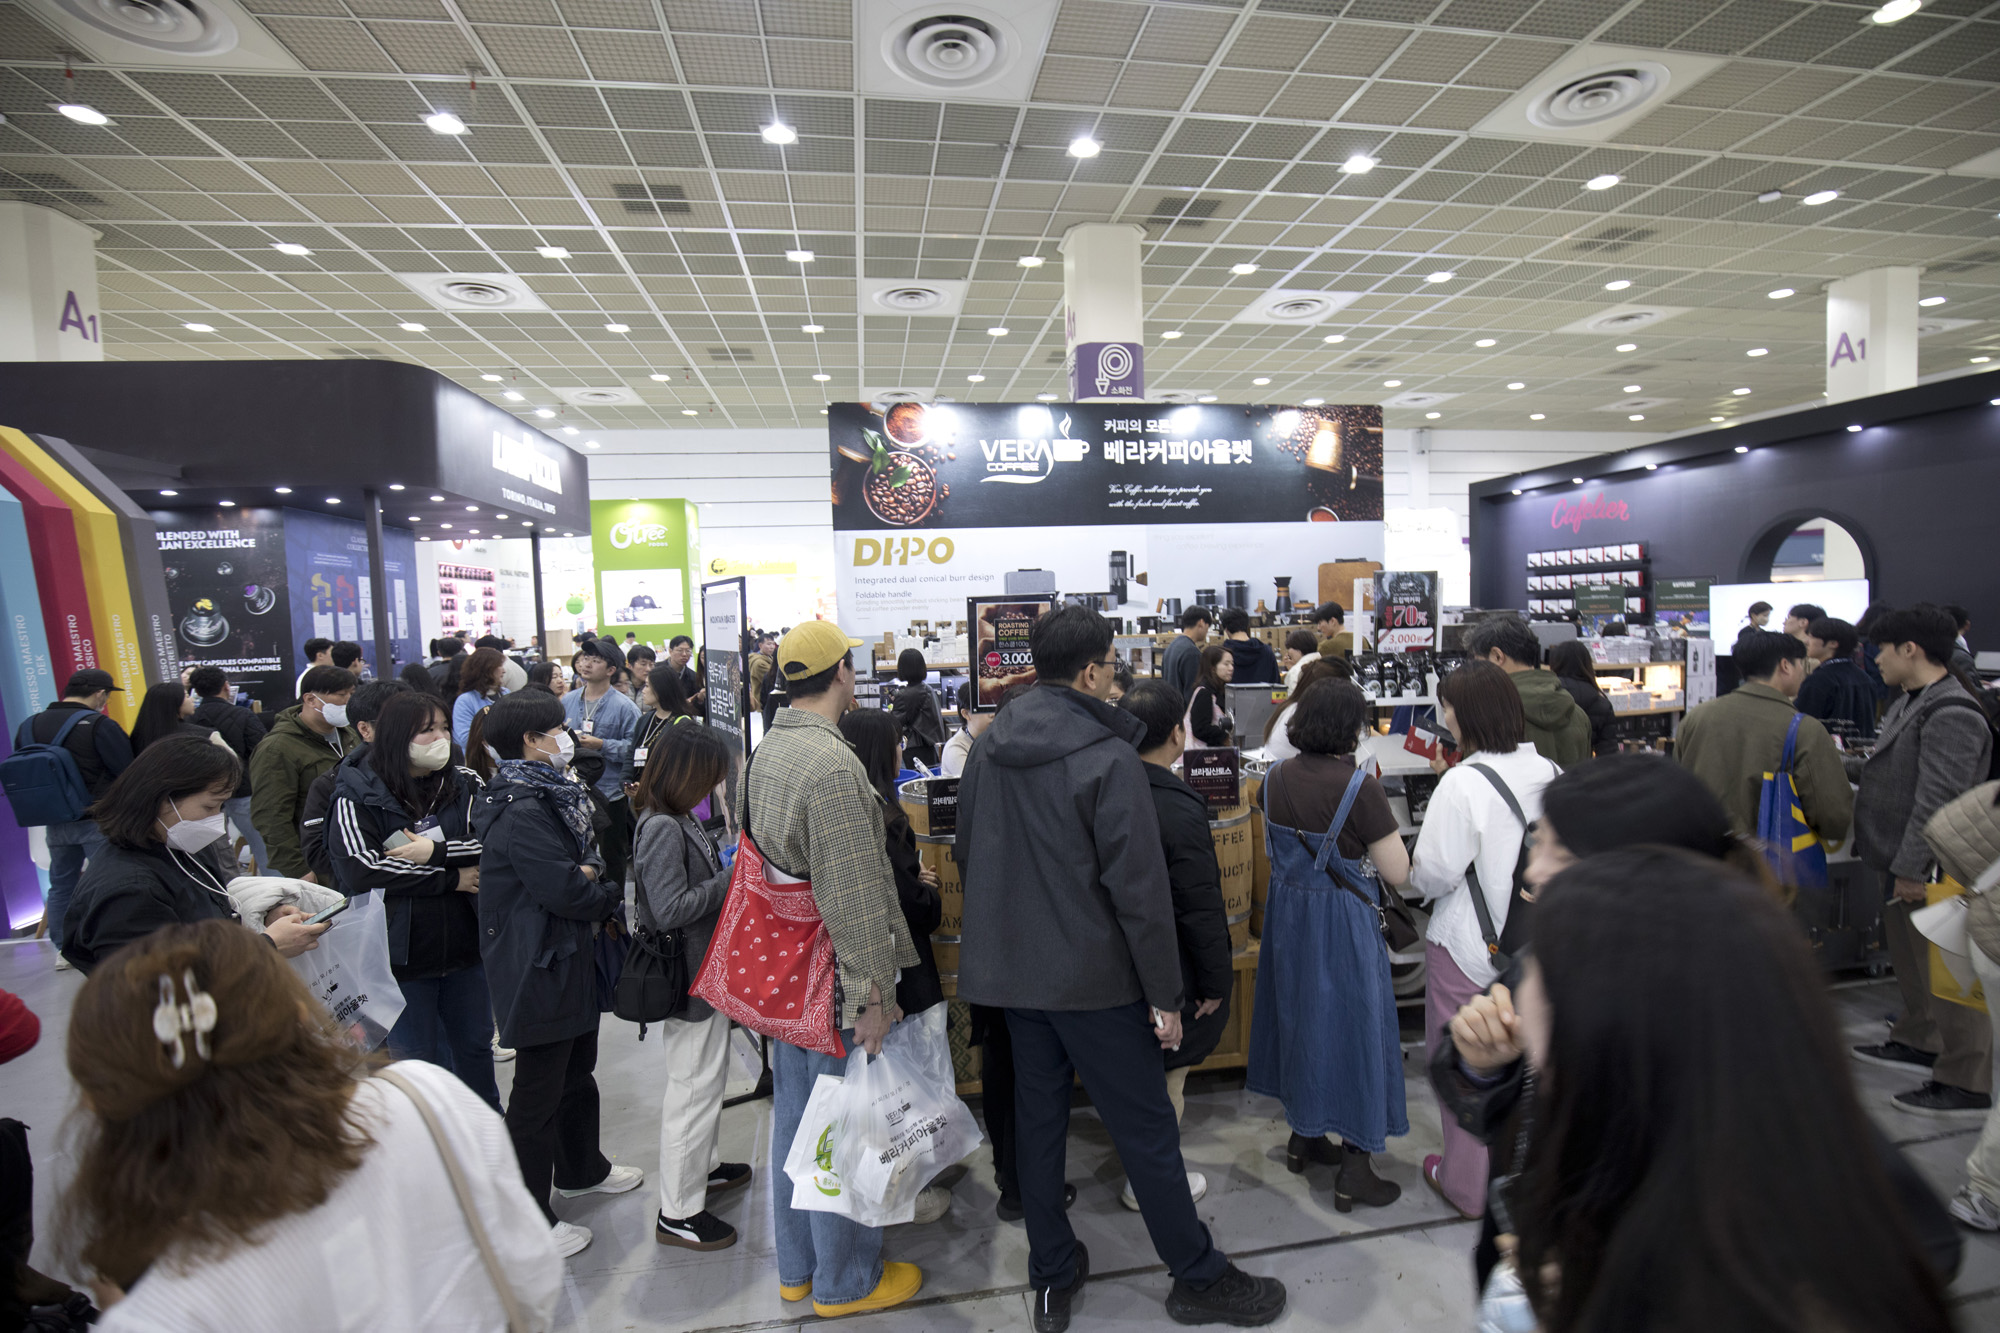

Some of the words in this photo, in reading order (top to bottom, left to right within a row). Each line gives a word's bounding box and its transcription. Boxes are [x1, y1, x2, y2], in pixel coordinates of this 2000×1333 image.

[59, 290, 98, 343] A1
[1830, 332, 1866, 368] A1
[1111, 386, 1133, 395] 소화전
[1104, 419, 1142, 433] 커피의
[1104, 439, 1253, 464] 베라커피아울렛
[986, 462, 1040, 471] COFFEE
[1551, 492, 1630, 534] Cafelier
[184, 539, 256, 549] EXCELLENCE
[207, 530, 239, 540] WITH
[855, 576, 897, 585] Integrated
[899, 575, 917, 584] dual
[919, 574, 947, 583] conical
[949, 574, 967, 582] burr
[968, 572, 995, 582] design
[855, 591, 886, 599] Foldable
[888, 590, 912, 598] handle
[1393, 605, 1428, 627] 70%
[15, 614, 33, 665] MAESTRO
[67, 614, 84, 662] MAESTRO
[112, 614, 128, 660] MAESTRO
[151, 614, 167, 657] MAESTRO
[35, 654, 48, 675] DEK
[82, 639, 97, 670] SSICO
[127, 642, 140, 675] LUNGO
[164, 634, 179, 679] RISTRETTO
[237, 657, 281, 665] COMPATIBLE
[1002, 653, 1033, 664] 3,000
[242, 664, 282, 672] MACHINES
[708, 660, 728, 686] 원두커피
[25, 667, 43, 714] SPRESSO
[119, 661, 136, 707] ESPRESSO
[709, 687, 735, 721] 납품문의
[1190, 767, 1233, 776] 브라질산토스
[1213, 830, 1244, 846] FFEE
[336, 993, 369, 1023] 피아울렛
[878, 1113, 948, 1165] 베라커피아울렛
